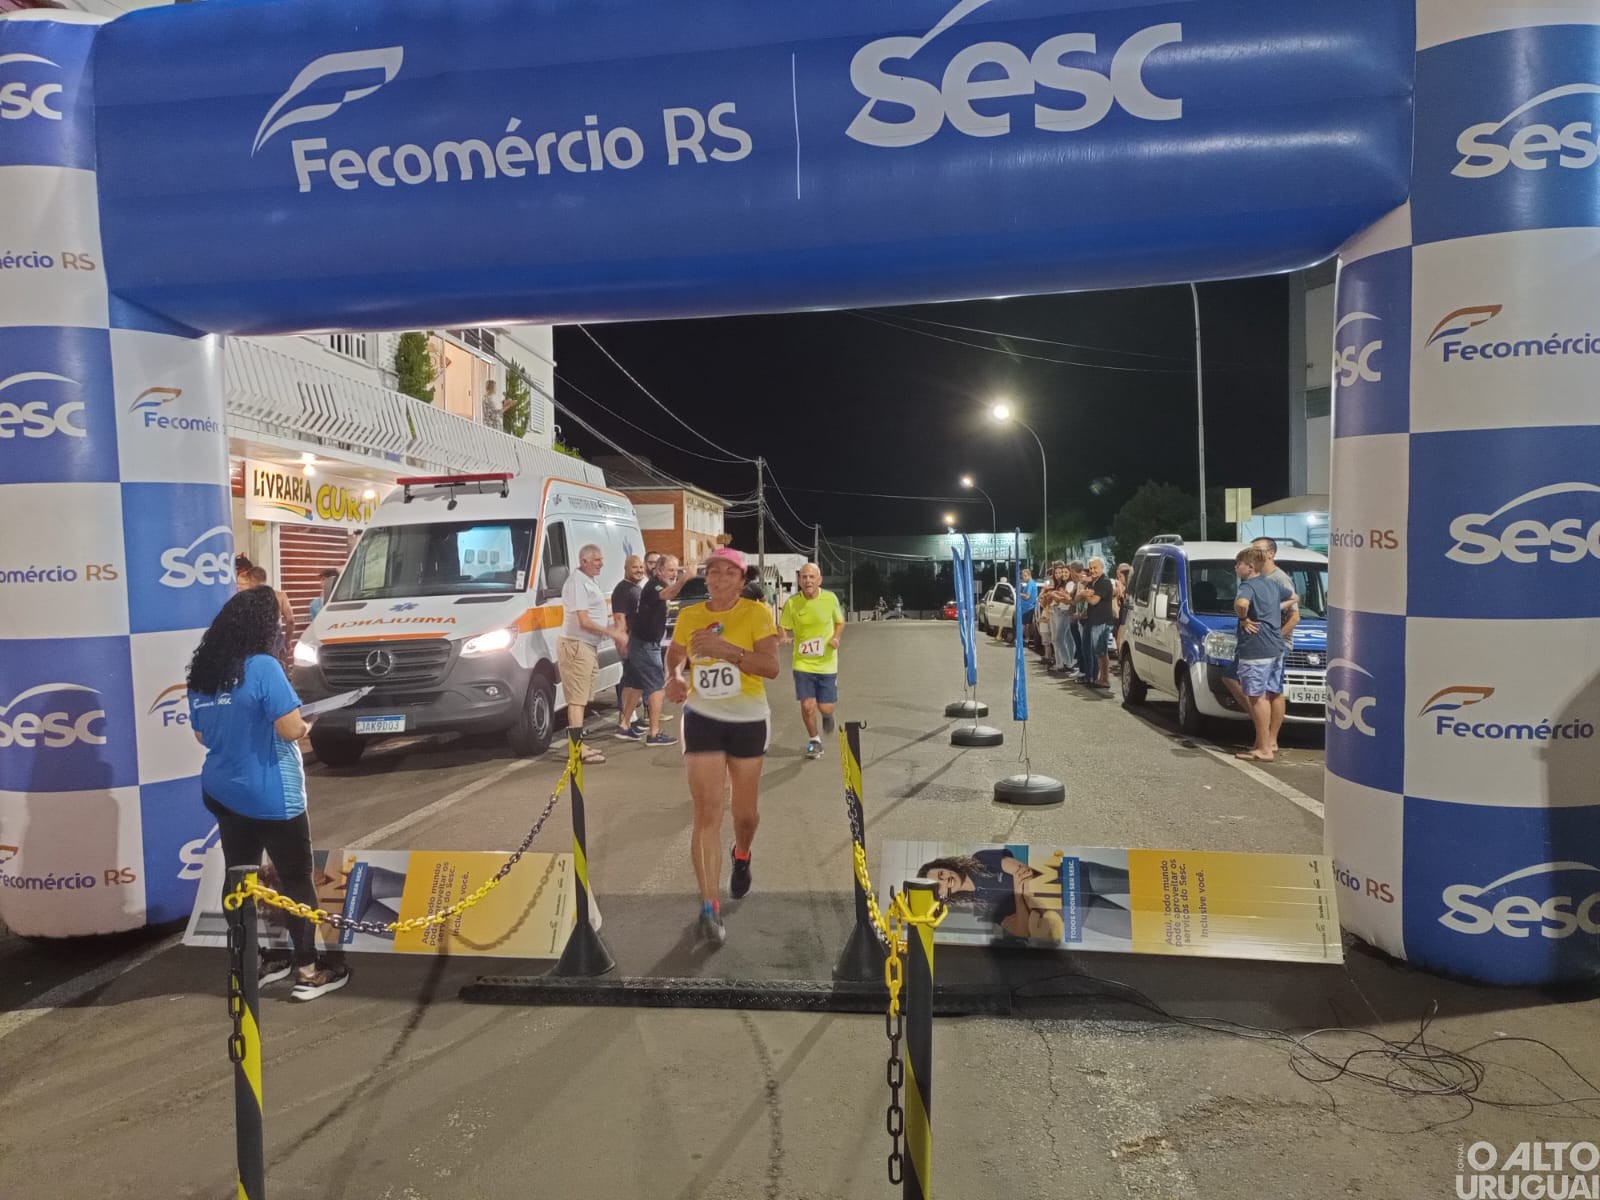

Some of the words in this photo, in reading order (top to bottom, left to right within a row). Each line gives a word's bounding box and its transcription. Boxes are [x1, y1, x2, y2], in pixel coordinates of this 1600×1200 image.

[845, 21, 1183, 148] Sesc
[0, 82, 63, 120] sc
[291, 115, 645, 192] Fecomércio
[663, 102, 753, 167] RS
[1450, 121, 1600, 178] Ses
[0, 251, 54, 269] ércio
[61, 252, 96, 271] RS
[1369, 529, 1399, 549] RS
[85, 563, 119, 581] RS
[801, 640, 821, 654] 217
[700, 666, 734, 689] 876
[1436, 715, 1594, 740] Fecomércio
[1169, 858, 1177, 869] os
[104, 867, 137, 886] RS
[1160, 860, 1170, 892] mundo
[1180, 889, 1189, 901] do
[1366, 878, 1395, 904] RS
